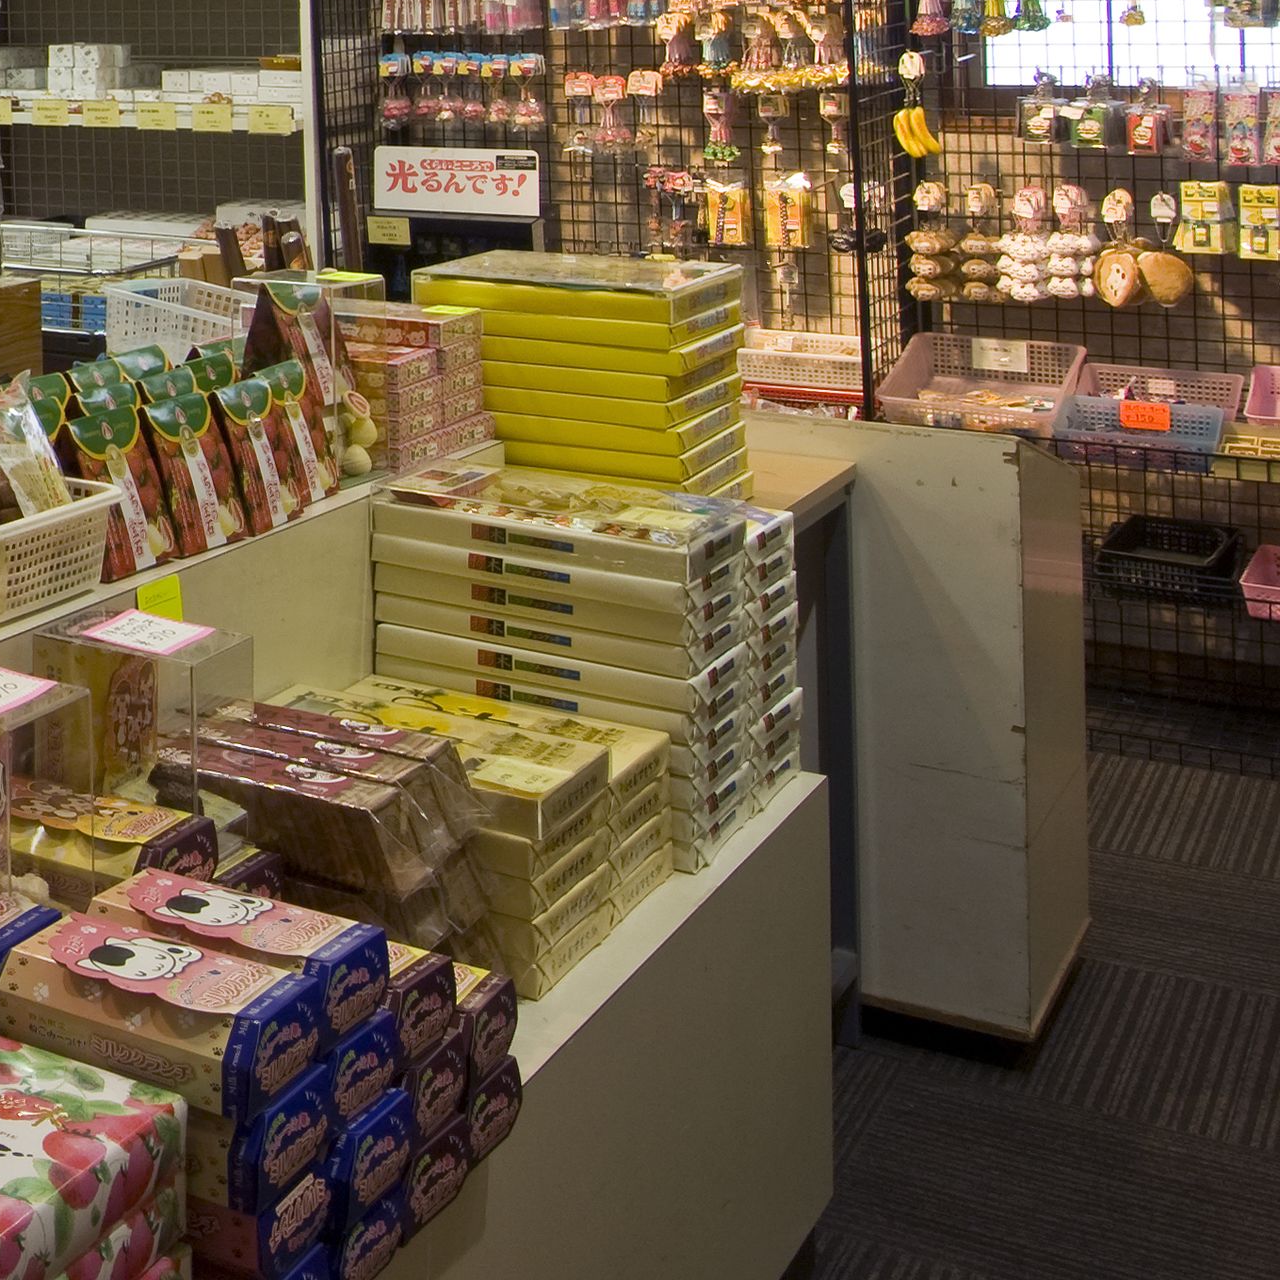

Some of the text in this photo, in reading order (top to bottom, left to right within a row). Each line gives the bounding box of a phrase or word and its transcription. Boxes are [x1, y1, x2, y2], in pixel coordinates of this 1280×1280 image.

[385, 159, 527, 197] 光るんです!
[423, 160, 492, 172] くらいところで
[90, 1032, 194, 1084] ミルククランチ
[0, 1129, 18, 1141] PIE
